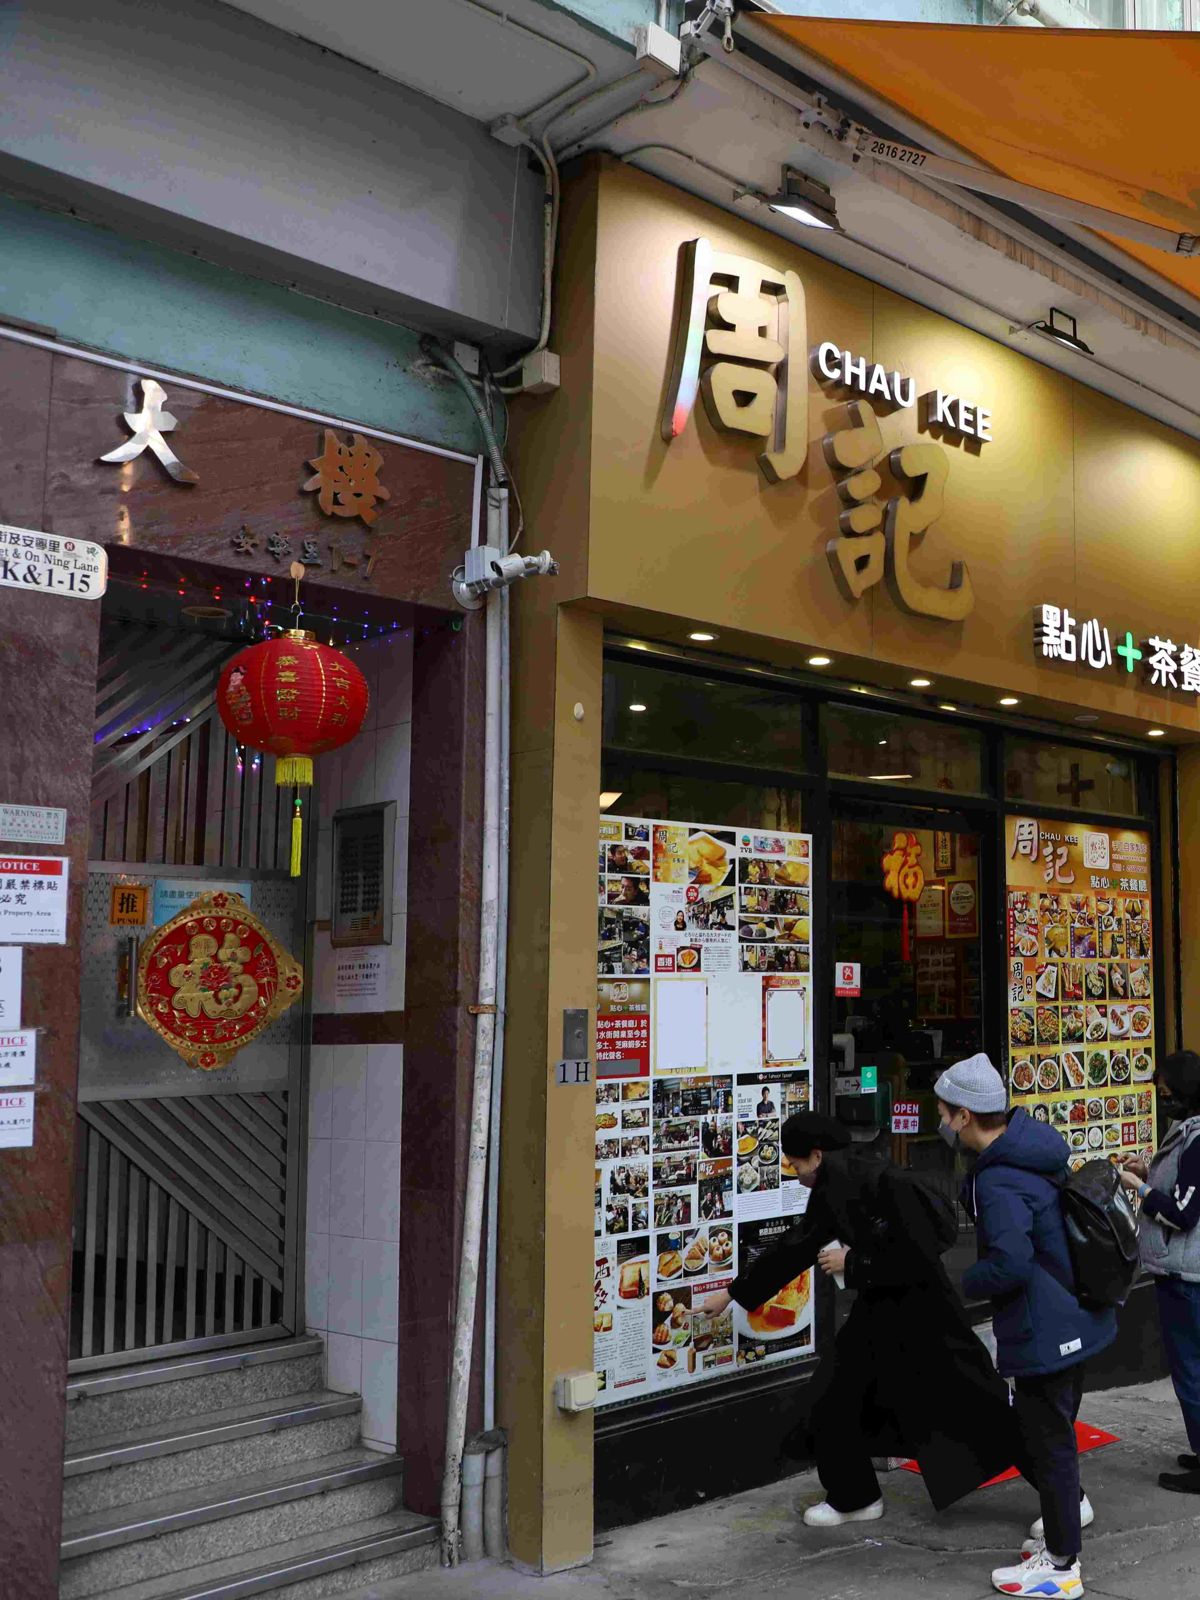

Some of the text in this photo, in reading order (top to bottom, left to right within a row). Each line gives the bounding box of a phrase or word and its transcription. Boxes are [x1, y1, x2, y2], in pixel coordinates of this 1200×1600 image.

[871, 141, 927, 167] 2816 2727
[817, 342, 993, 443] CHAU KEE
[662, 238, 975, 621] 周記
[12, 548, 21, 559] &
[25, 550, 40, 562] On
[43, 554, 70, 570] Ning
[73, 559, 99, 573] Lane
[1, 560, 91, 593] K&1-15
[1040, 832, 1079, 844] CHAU KEE
[1010, 818, 1075, 884] 周記
[0, 861, 40, 871] OTICE
[882, 831, 924, 902] 福
[0, 878, 58, 891] 嚴禁標貼
[118, 892, 138, 914] 推
[168, 933, 258, 1019] 福
[894, 1103, 919, 1114] OPEN
[894, 1118, 918, 1130] 營業中
